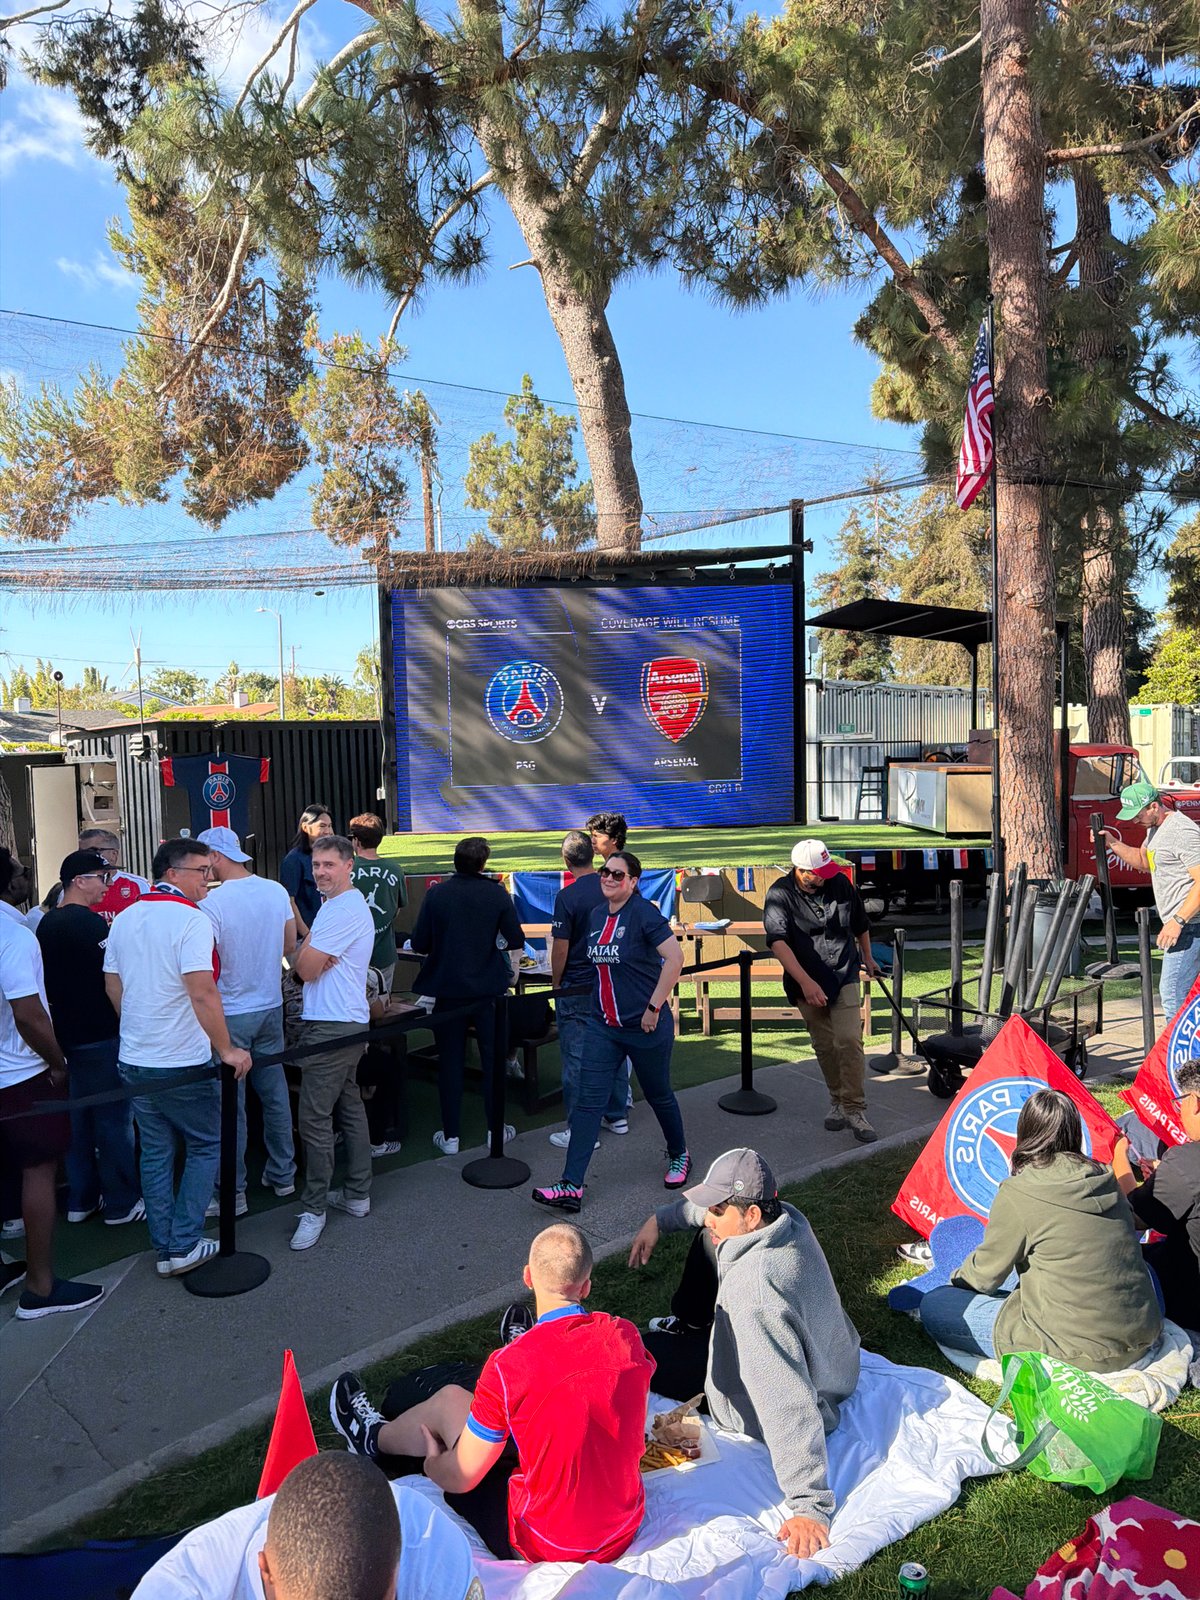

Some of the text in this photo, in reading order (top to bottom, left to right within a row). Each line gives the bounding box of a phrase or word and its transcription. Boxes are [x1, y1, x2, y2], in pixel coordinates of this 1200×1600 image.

[600, 617, 660, 629] COVERAGE
[662, 615, 691, 627] WILL
[650, 671, 699, 684] Arsenal
[516, 760, 536, 771] PSG
[653, 757, 699, 768] ARSENAL
